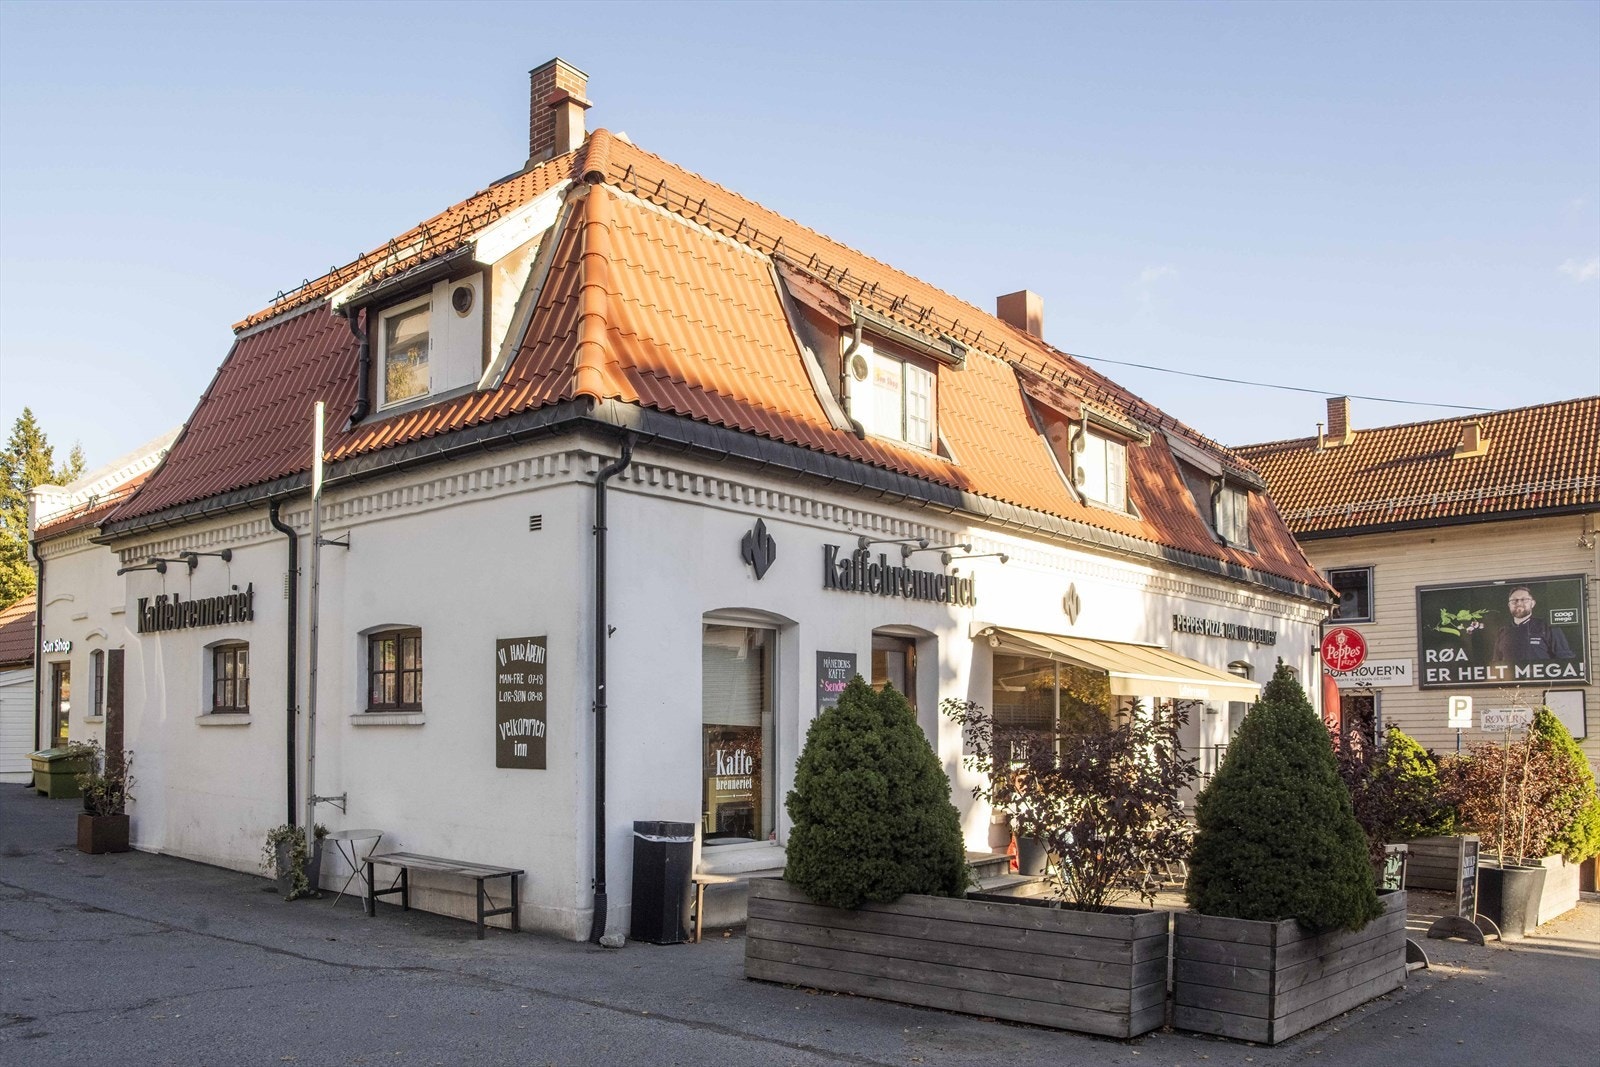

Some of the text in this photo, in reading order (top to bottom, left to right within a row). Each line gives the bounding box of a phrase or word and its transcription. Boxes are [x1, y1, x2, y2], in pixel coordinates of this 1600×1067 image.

[823, 543, 977, 607] Kaffebrenneriet
[137, 582, 255, 633] Kaffebrenneriet
[1177, 614, 1204, 635] PEPPES
[1205, 619, 1226, 638] PIZZA
[42, 638, 71, 654] Sun Shop
[498, 639, 546, 667] VI HAR ÅPENT
[1326, 643, 1361, 660] Peppes
[823, 656, 851, 669] MÅNEDENS
[1425, 647, 1469, 663] RØA
[499, 673, 524, 684] MAN-FRE
[828, 668, 846, 679] KAFFE
[1351, 665, 1405, 677] RØVER'N
[1426, 662, 1585, 682] ER HELT MEGA!
[498, 689, 526, 702] LØR-SØN
[1455, 699, 1468, 717] P
[514, 740, 528, 757] inn
[716, 749, 753, 776] Kaffe
[716, 776, 753, 790] brenneriet
